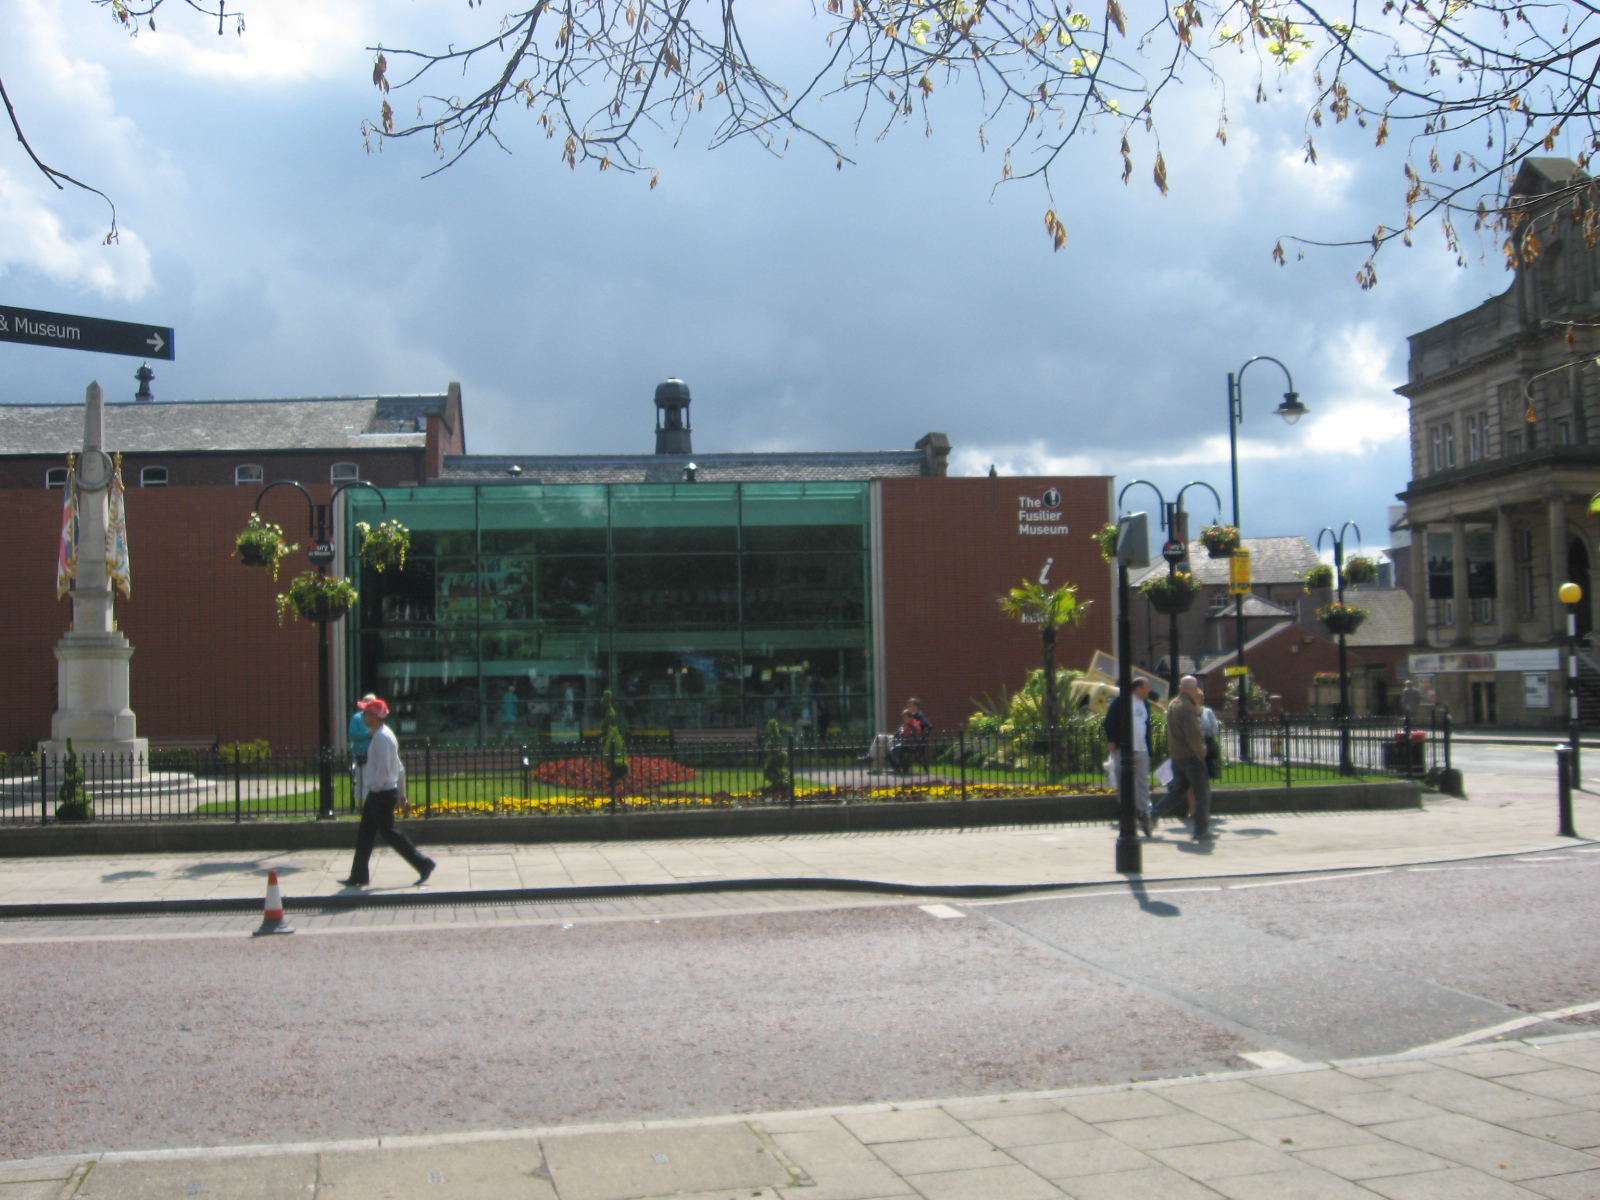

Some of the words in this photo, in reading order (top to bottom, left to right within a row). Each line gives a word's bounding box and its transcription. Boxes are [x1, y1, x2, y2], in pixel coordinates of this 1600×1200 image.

[14, 316, 81, 340] Museum
[1018, 496, 1042, 508] The
[1018, 510, 1062, 521] Fusilier
[1019, 524, 1069, 535] Museum
[310, 541, 329, 551] Bury
